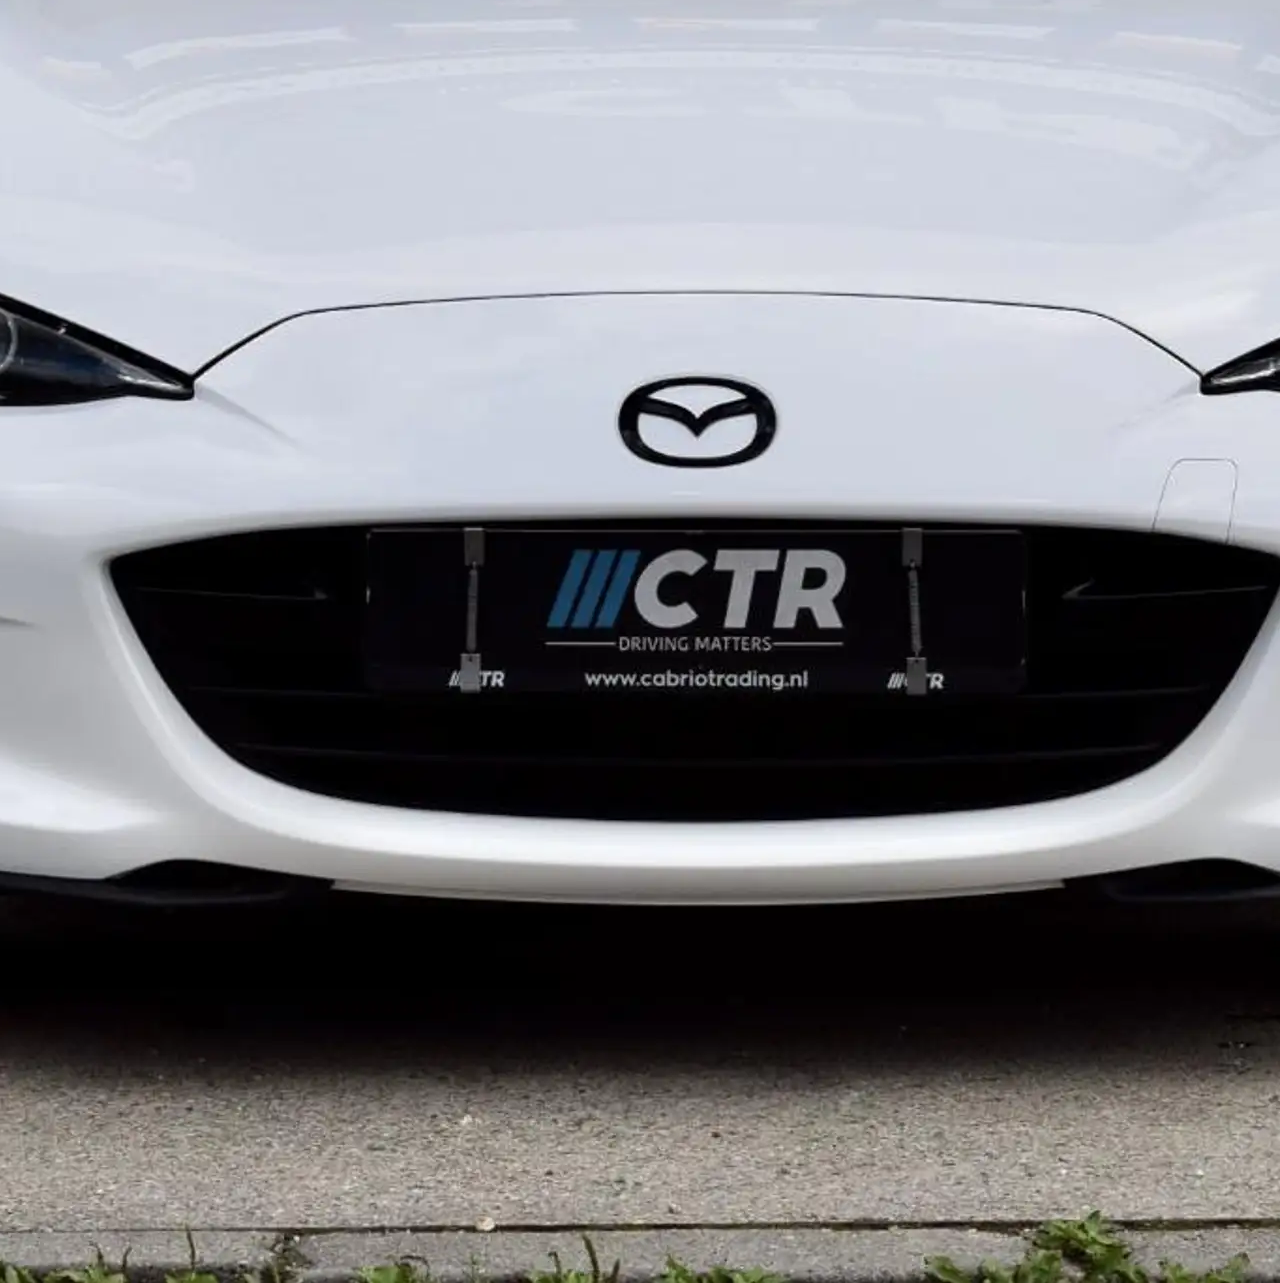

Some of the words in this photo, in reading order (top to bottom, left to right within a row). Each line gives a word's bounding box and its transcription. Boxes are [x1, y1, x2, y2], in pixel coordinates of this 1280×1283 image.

[634, 549, 847, 630] CTR
[618, 636, 689, 652] DRIVING
[693, 636, 773, 652] MATTERS
[584, 669, 809, 691] www.cabriotrading.nl
